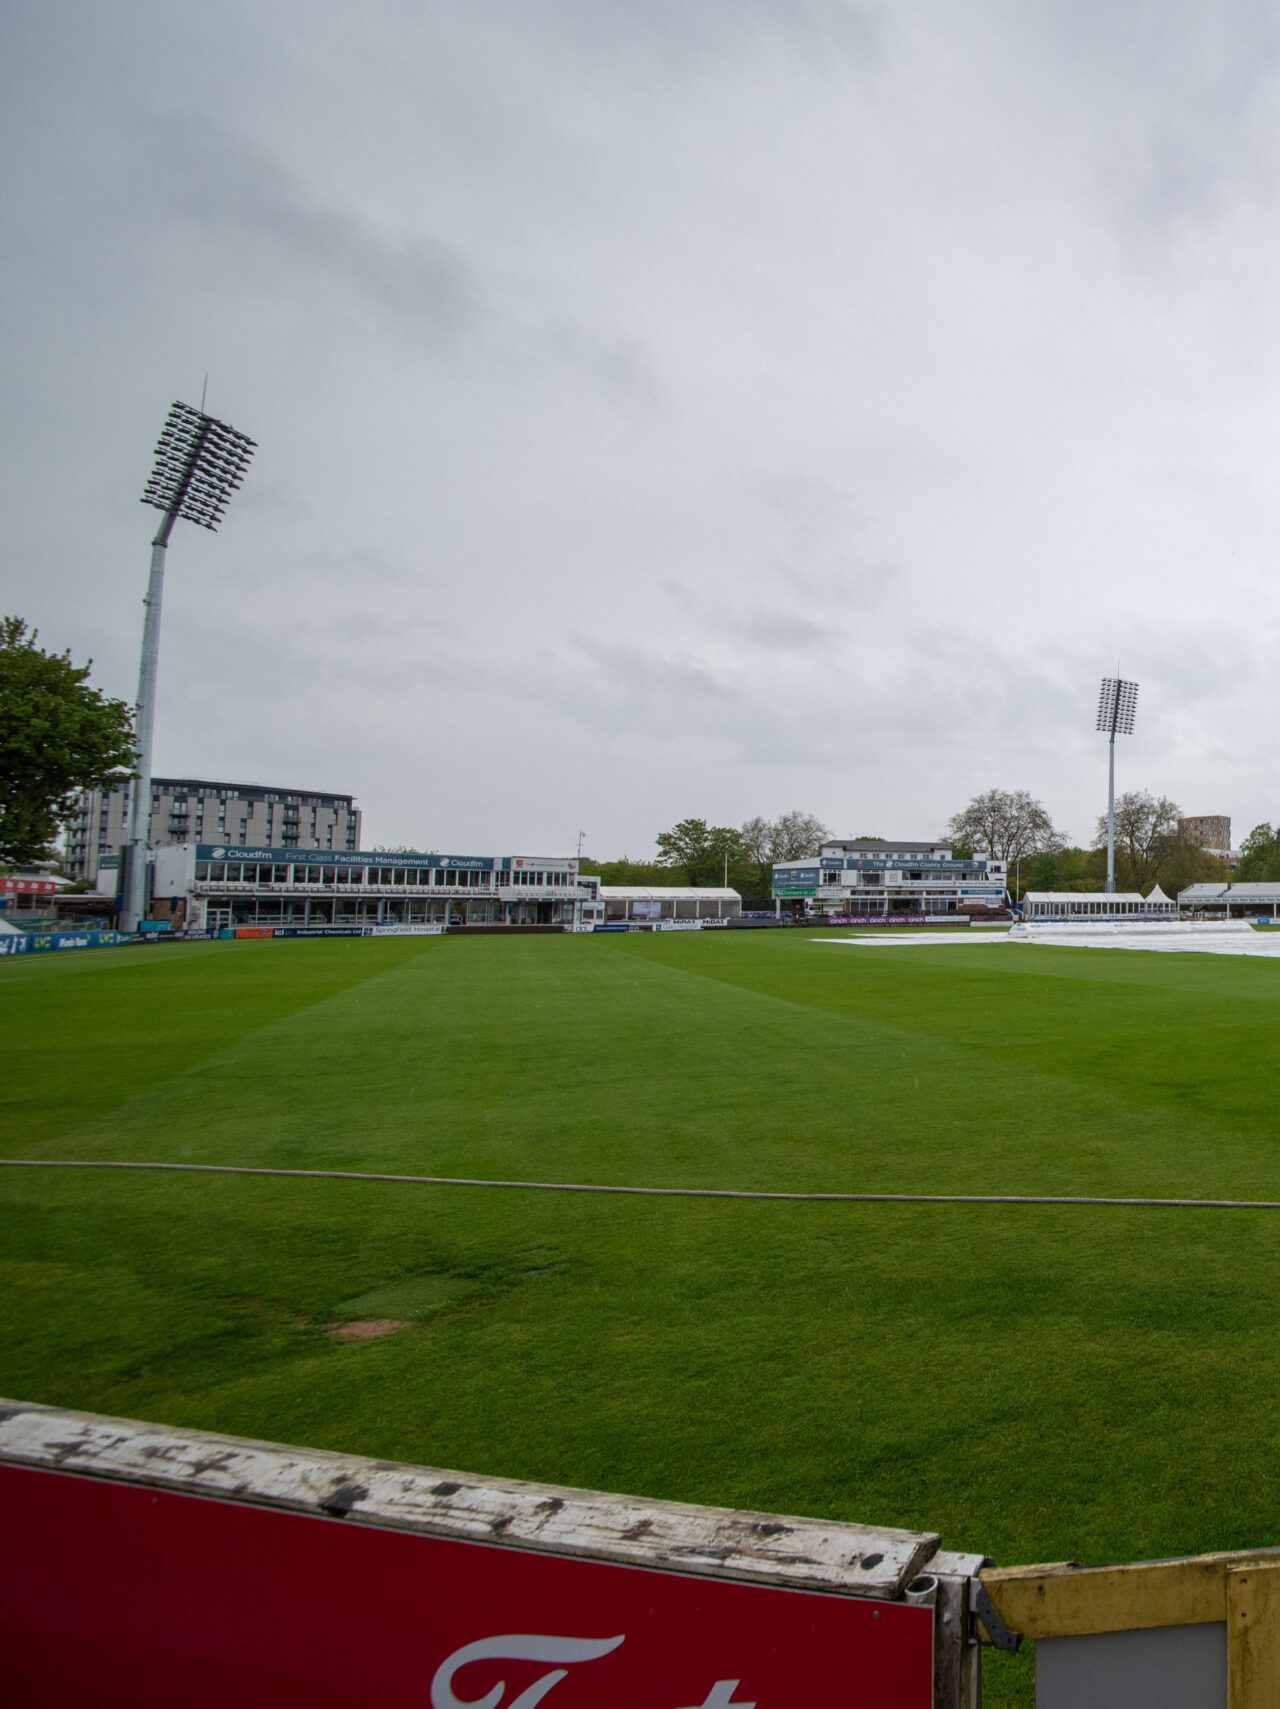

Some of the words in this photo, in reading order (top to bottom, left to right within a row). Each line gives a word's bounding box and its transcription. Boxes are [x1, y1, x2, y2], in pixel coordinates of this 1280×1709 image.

[227, 849, 272, 860] Cloudfm
[285, 852, 306, 861] First
[308, 853, 332, 862] Class
[334, 854, 374, 864] Facilities
[375, 856, 428, 867] Management
[450, 859, 484, 868] Cloudfm
[919, 861, 941, 869] County
[375, 926, 412, 934] Springfield
[413, 925, 441, 933] Hospital
